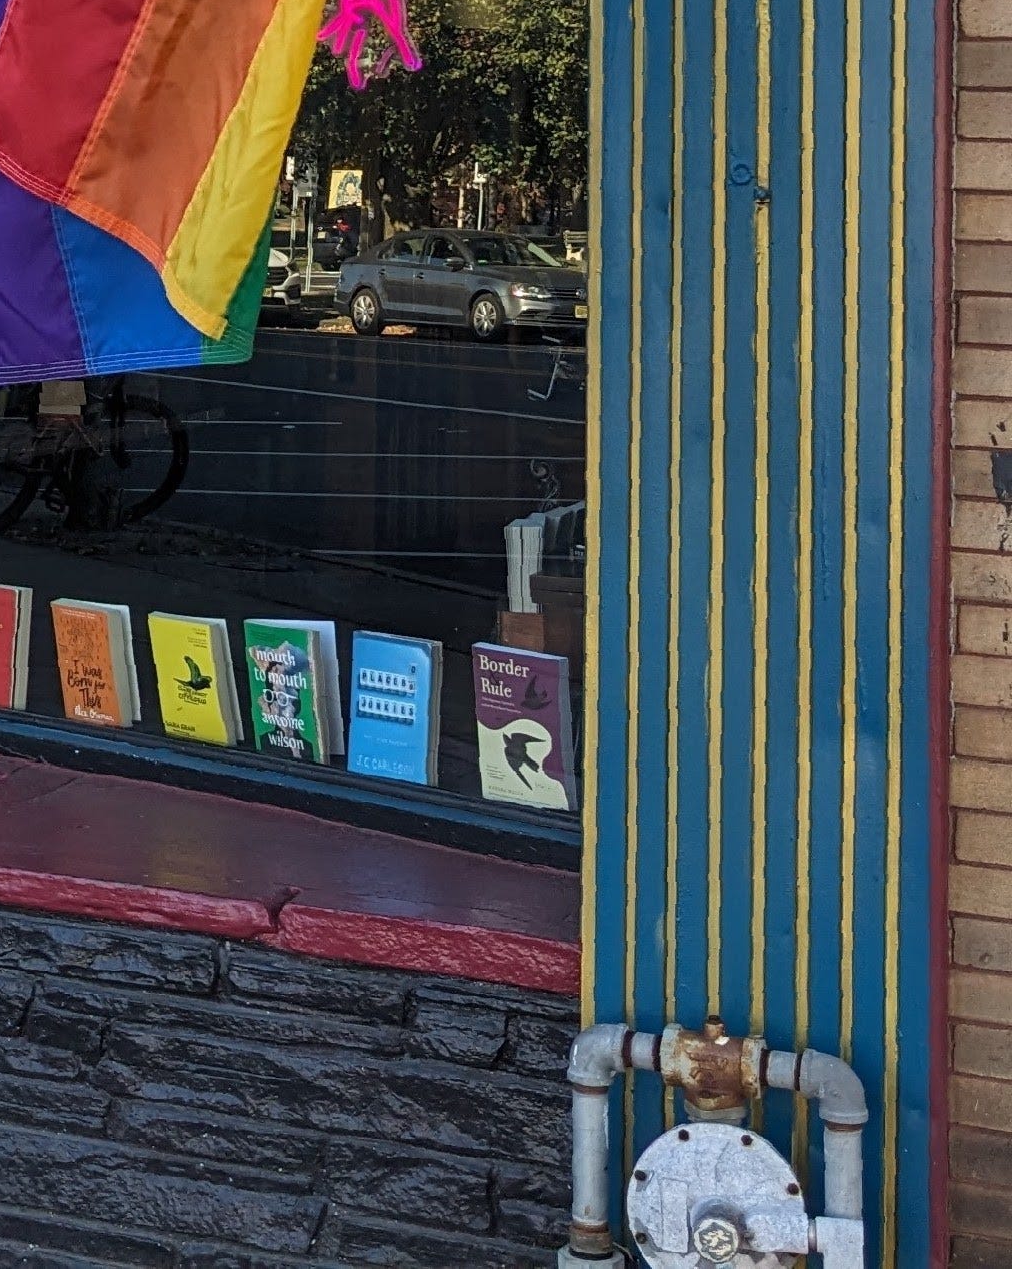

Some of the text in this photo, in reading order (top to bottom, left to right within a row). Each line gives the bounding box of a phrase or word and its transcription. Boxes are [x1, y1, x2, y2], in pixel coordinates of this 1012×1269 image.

[256, 650, 296, 667] mouth
[478, 653, 530, 678] Border
[254, 667, 307, 690] to mouth
[480, 677, 513, 698] Rule
[262, 712, 305, 731] antoine
[268, 730, 305, 750] wilson
